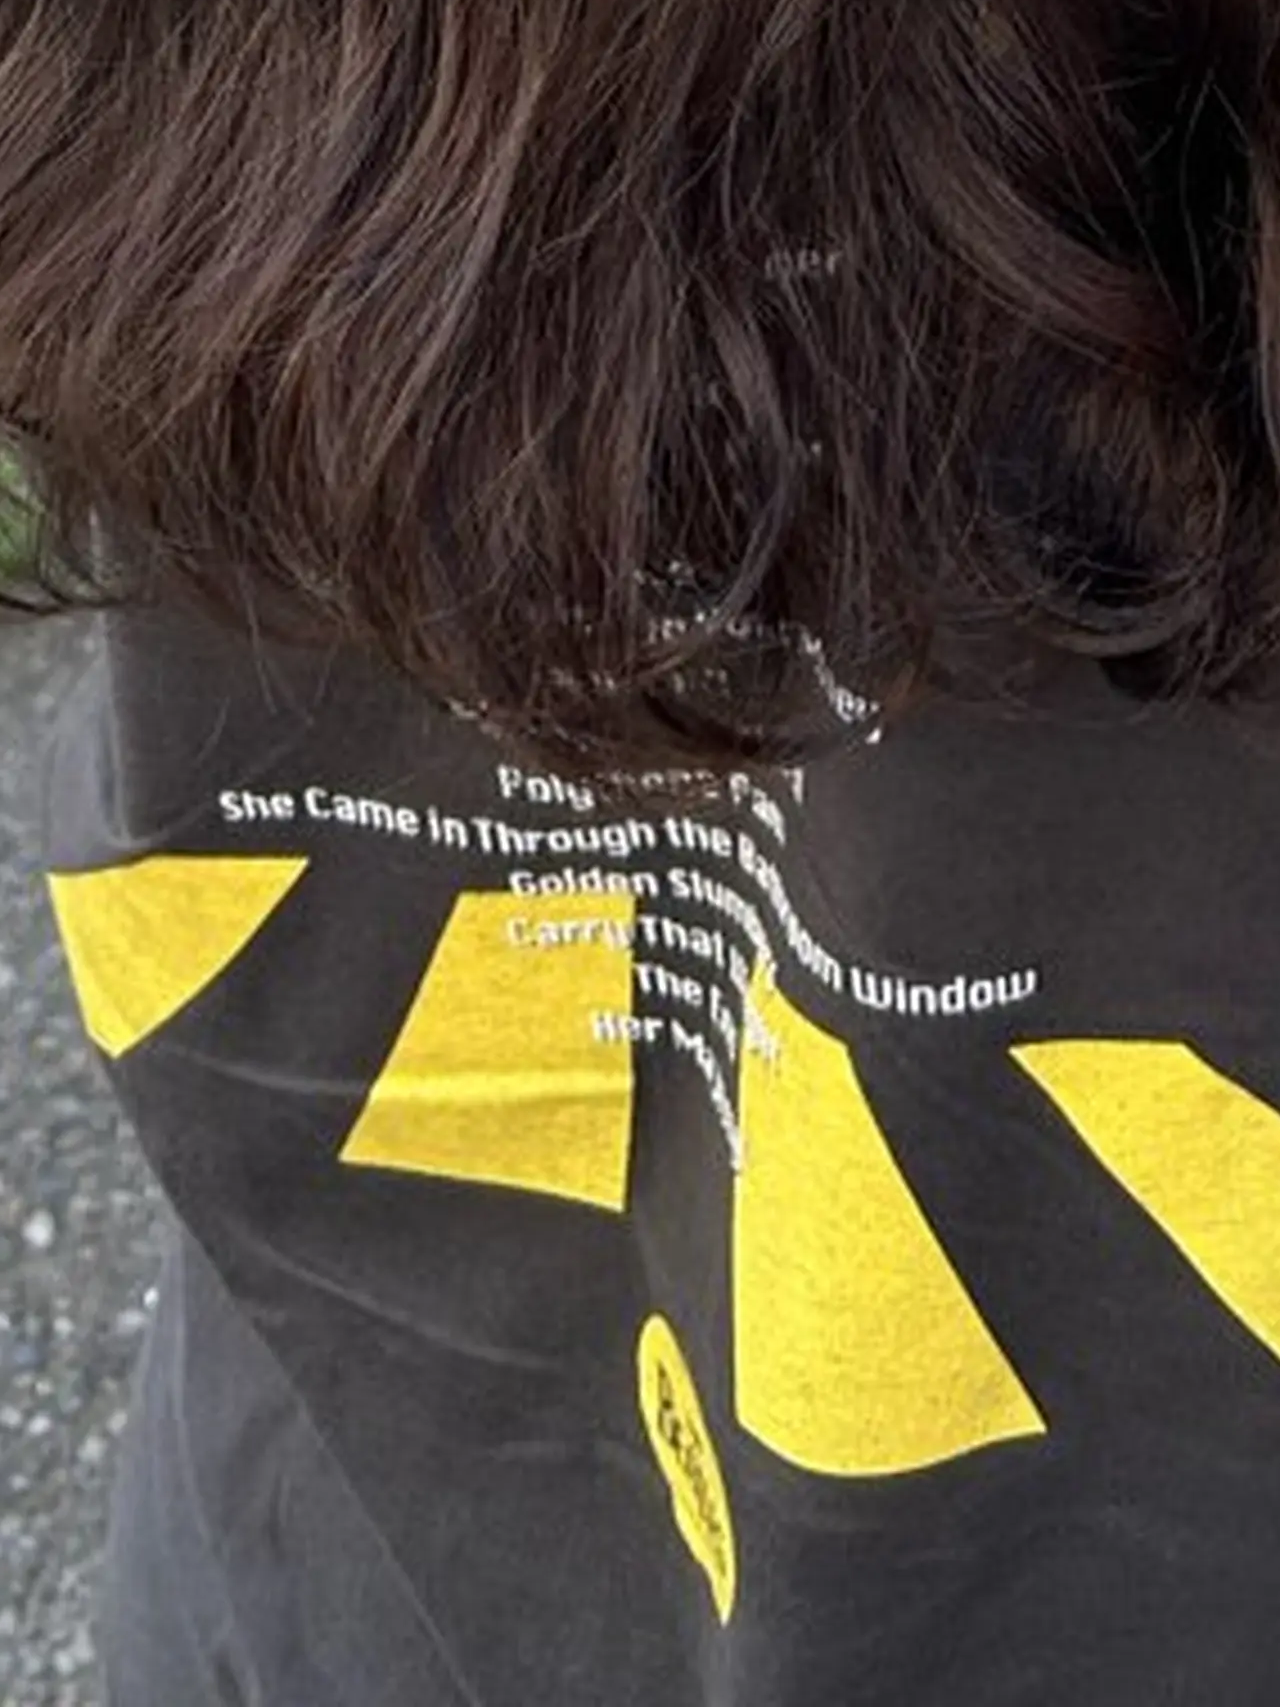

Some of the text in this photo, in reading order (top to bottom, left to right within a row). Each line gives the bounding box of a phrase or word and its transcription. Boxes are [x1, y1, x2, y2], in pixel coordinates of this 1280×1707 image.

[219, 790, 295, 821] She
[304, 786, 419, 836] Came
[471, 816, 656, 856] Through
[665, 816, 733, 857] the
[850, 964, 1037, 1015] Window
[508, 866, 659, 898] Golden
[506, 915, 724, 968] Carry That
[631, 962, 704, 1007] The
[590, 1010, 664, 1043] Her
